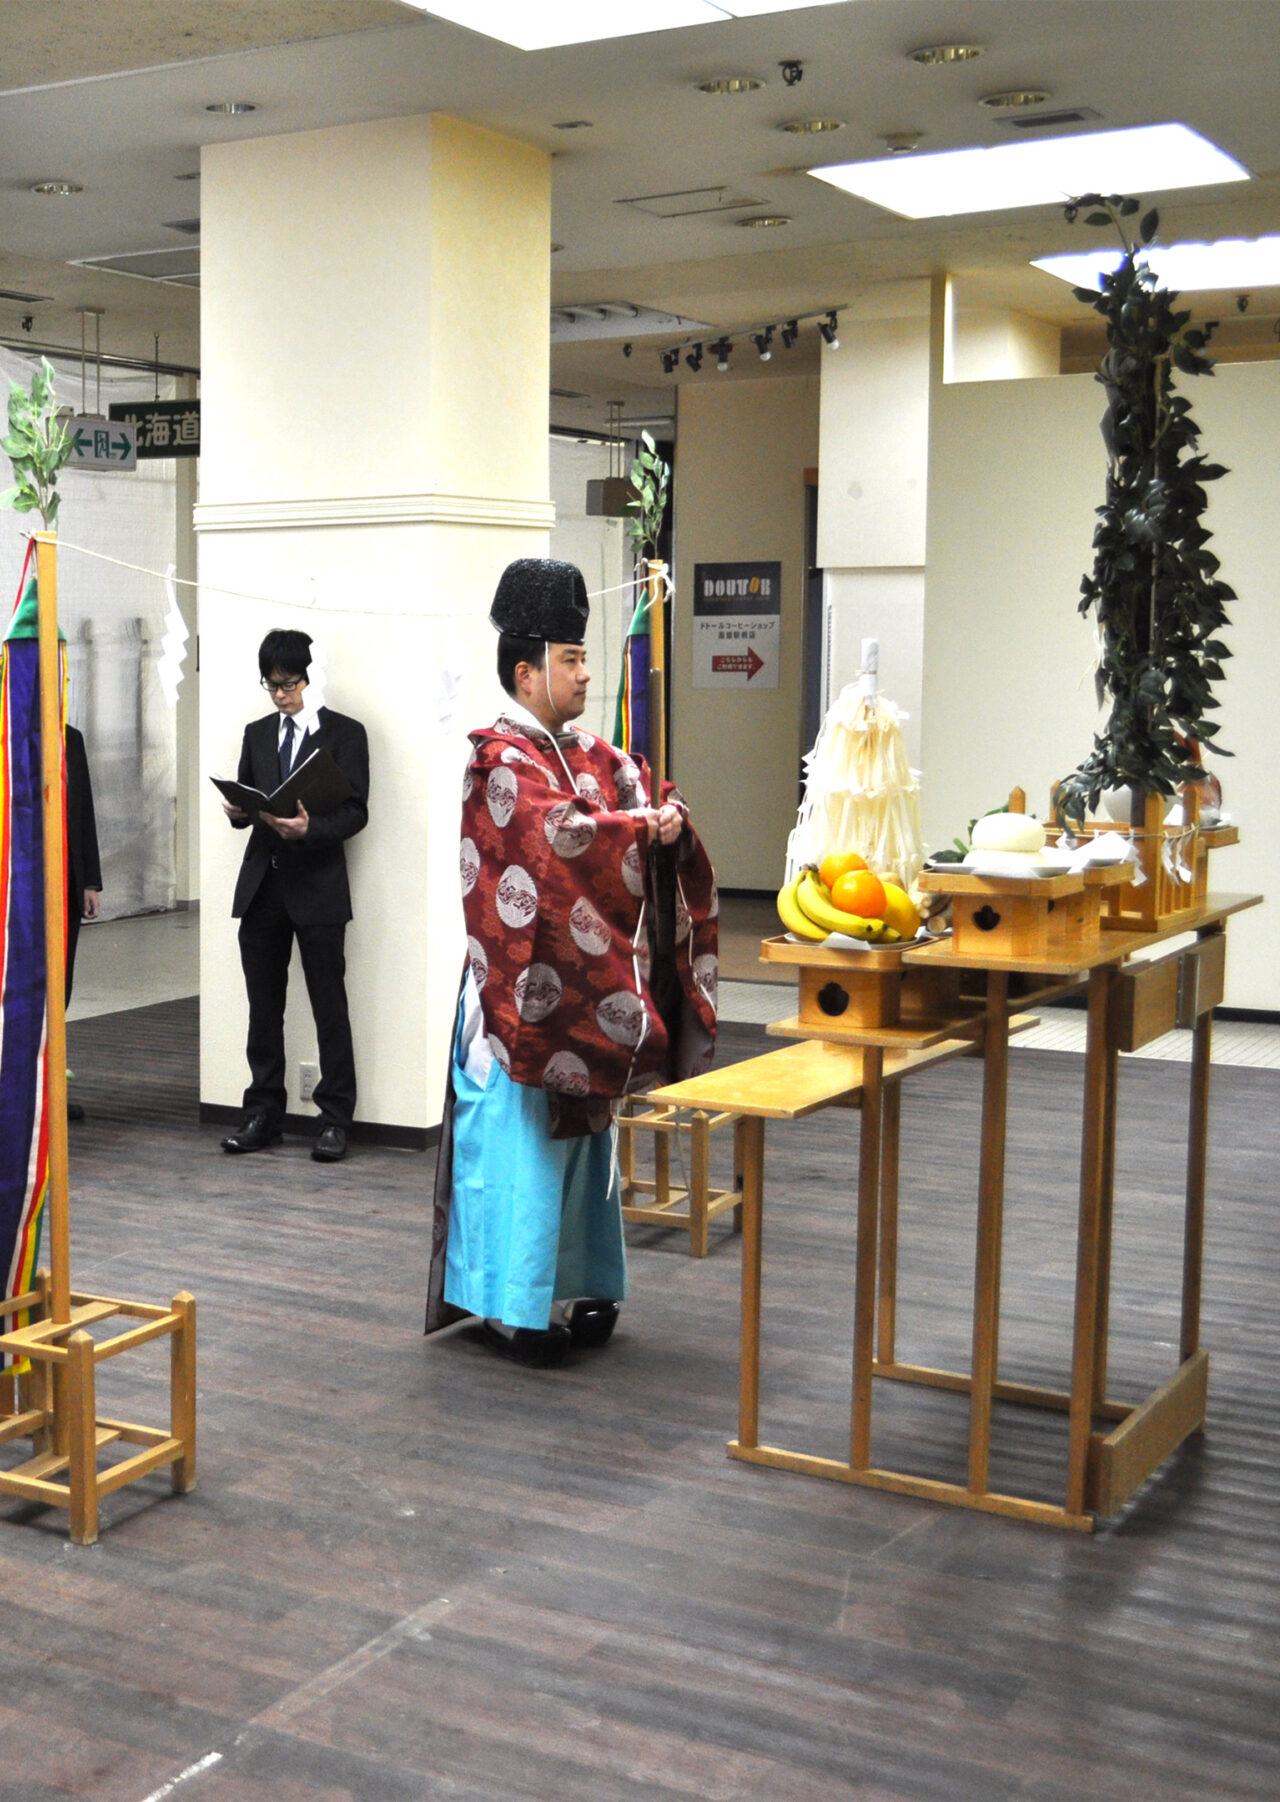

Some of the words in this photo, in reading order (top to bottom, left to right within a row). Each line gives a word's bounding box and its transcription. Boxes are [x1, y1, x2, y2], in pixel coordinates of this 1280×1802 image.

[704, 577, 771, 597] DOUTOR
[700, 621, 776, 630] ドトールコーヒーショップ
